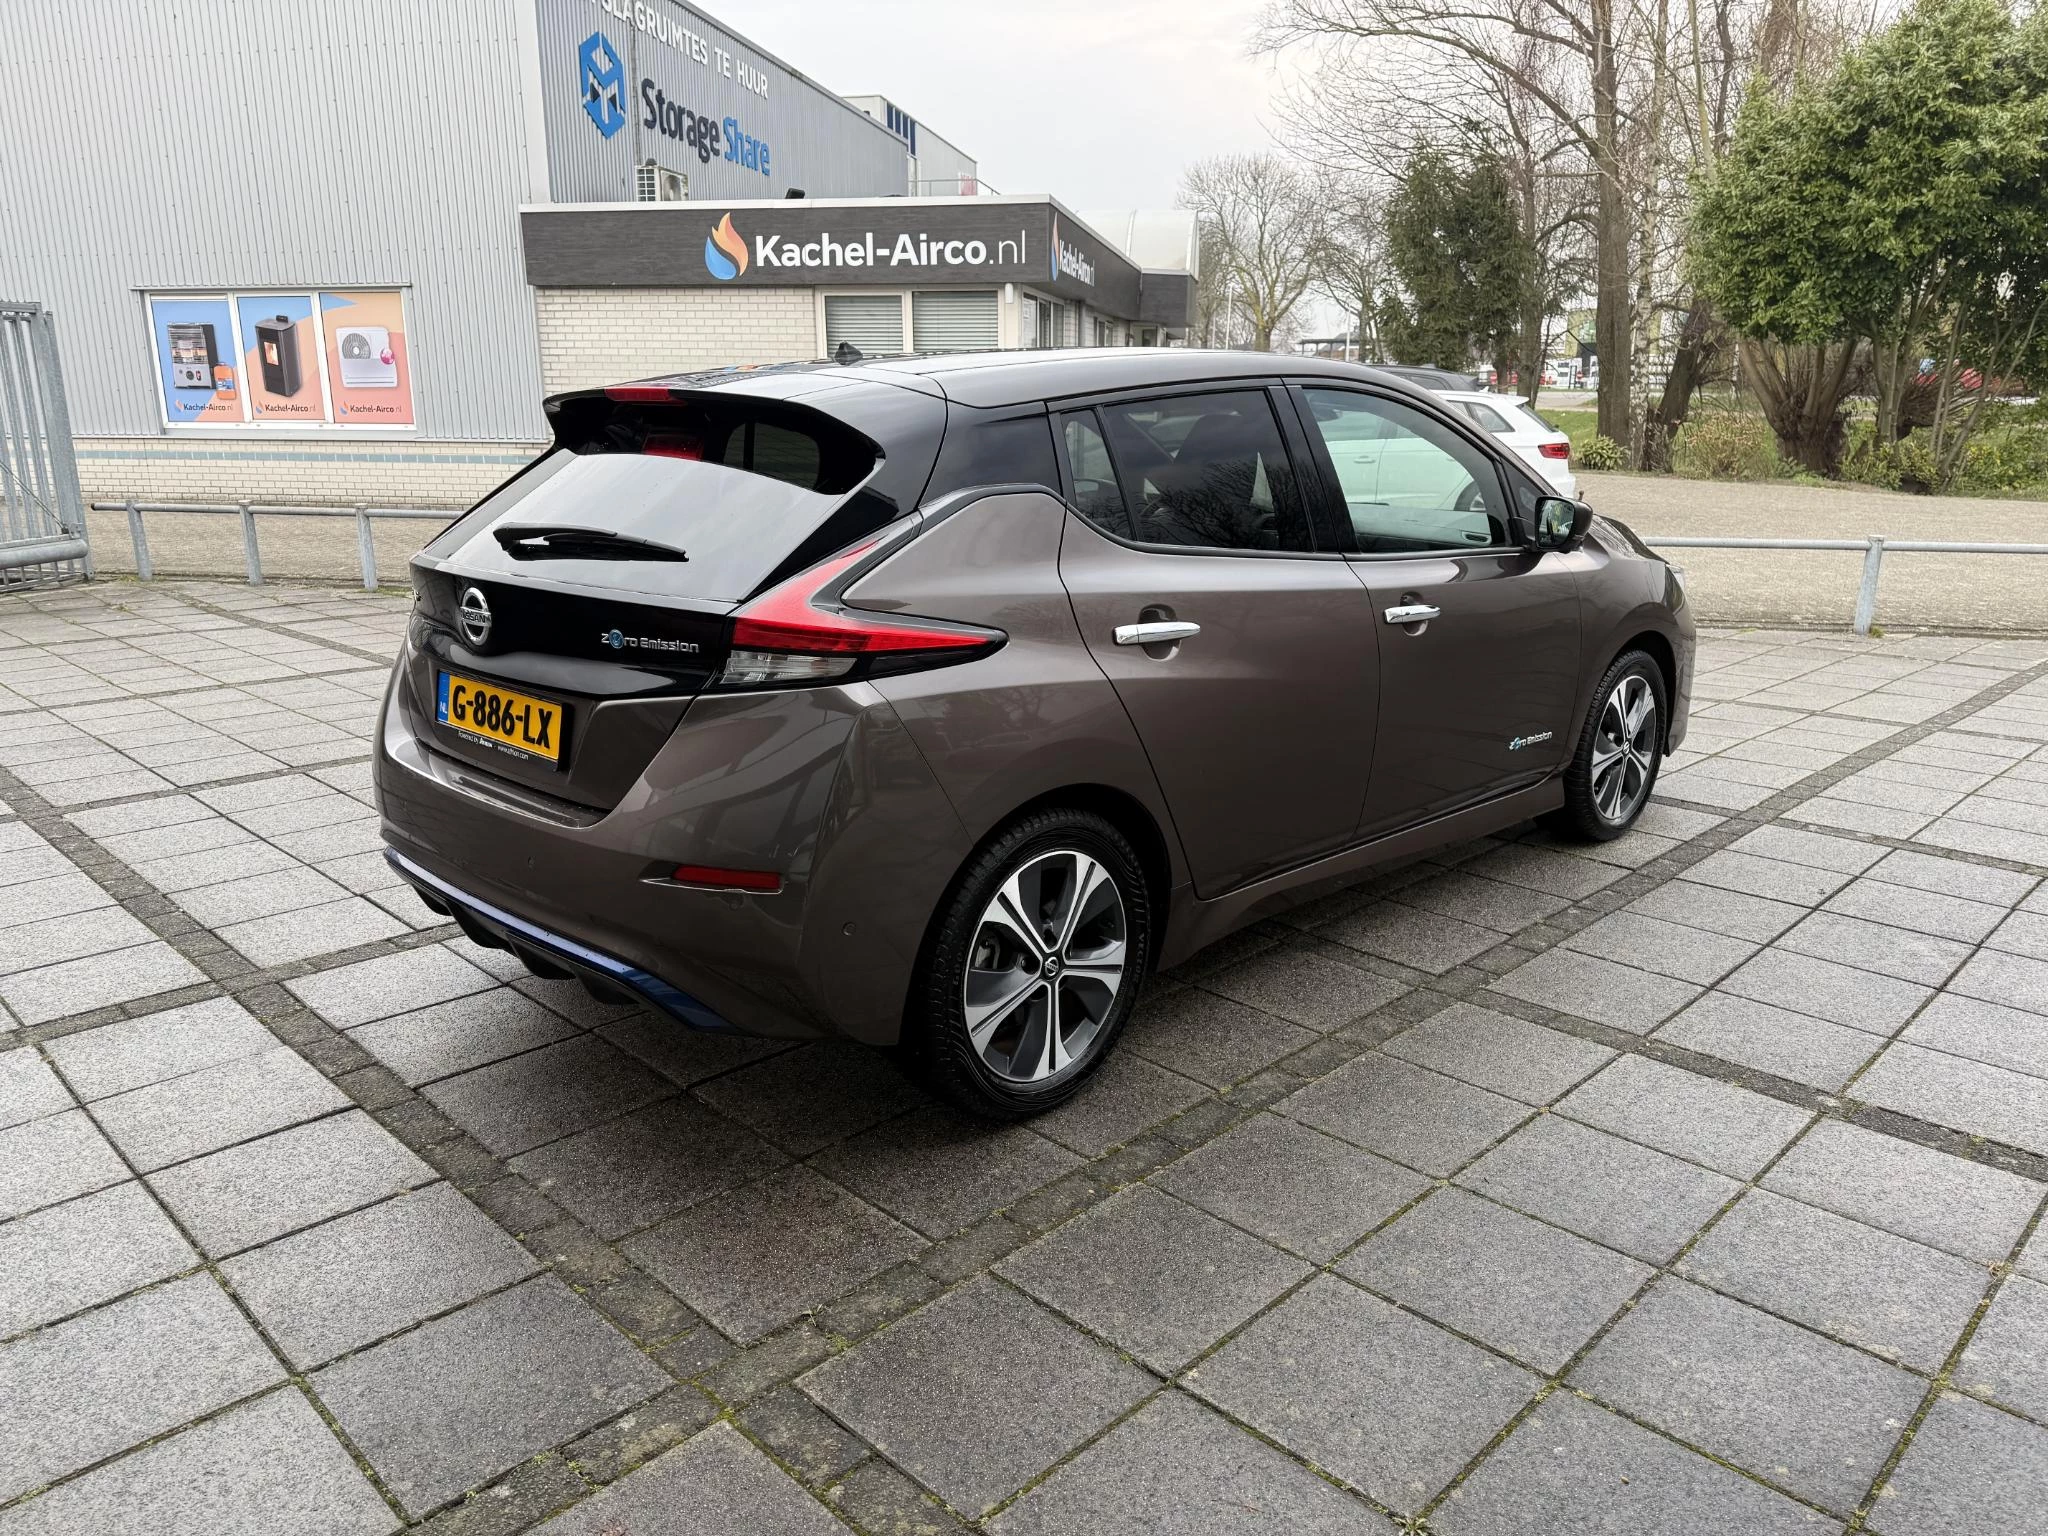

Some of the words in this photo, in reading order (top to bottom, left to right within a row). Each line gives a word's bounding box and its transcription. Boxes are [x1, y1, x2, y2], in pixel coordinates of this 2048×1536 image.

[714, 47, 731, 79] TE
[737, 59, 769, 100] HUUR
[641, 78, 721, 164] Storage
[723, 116, 770, 176] Share
[755, 229, 1026, 267] Kachel-Airco.nl
[640, 638, 699, 653] Emission
[440, 701, 448, 714] NL
[453, 685, 552, 749] G-886-LX
